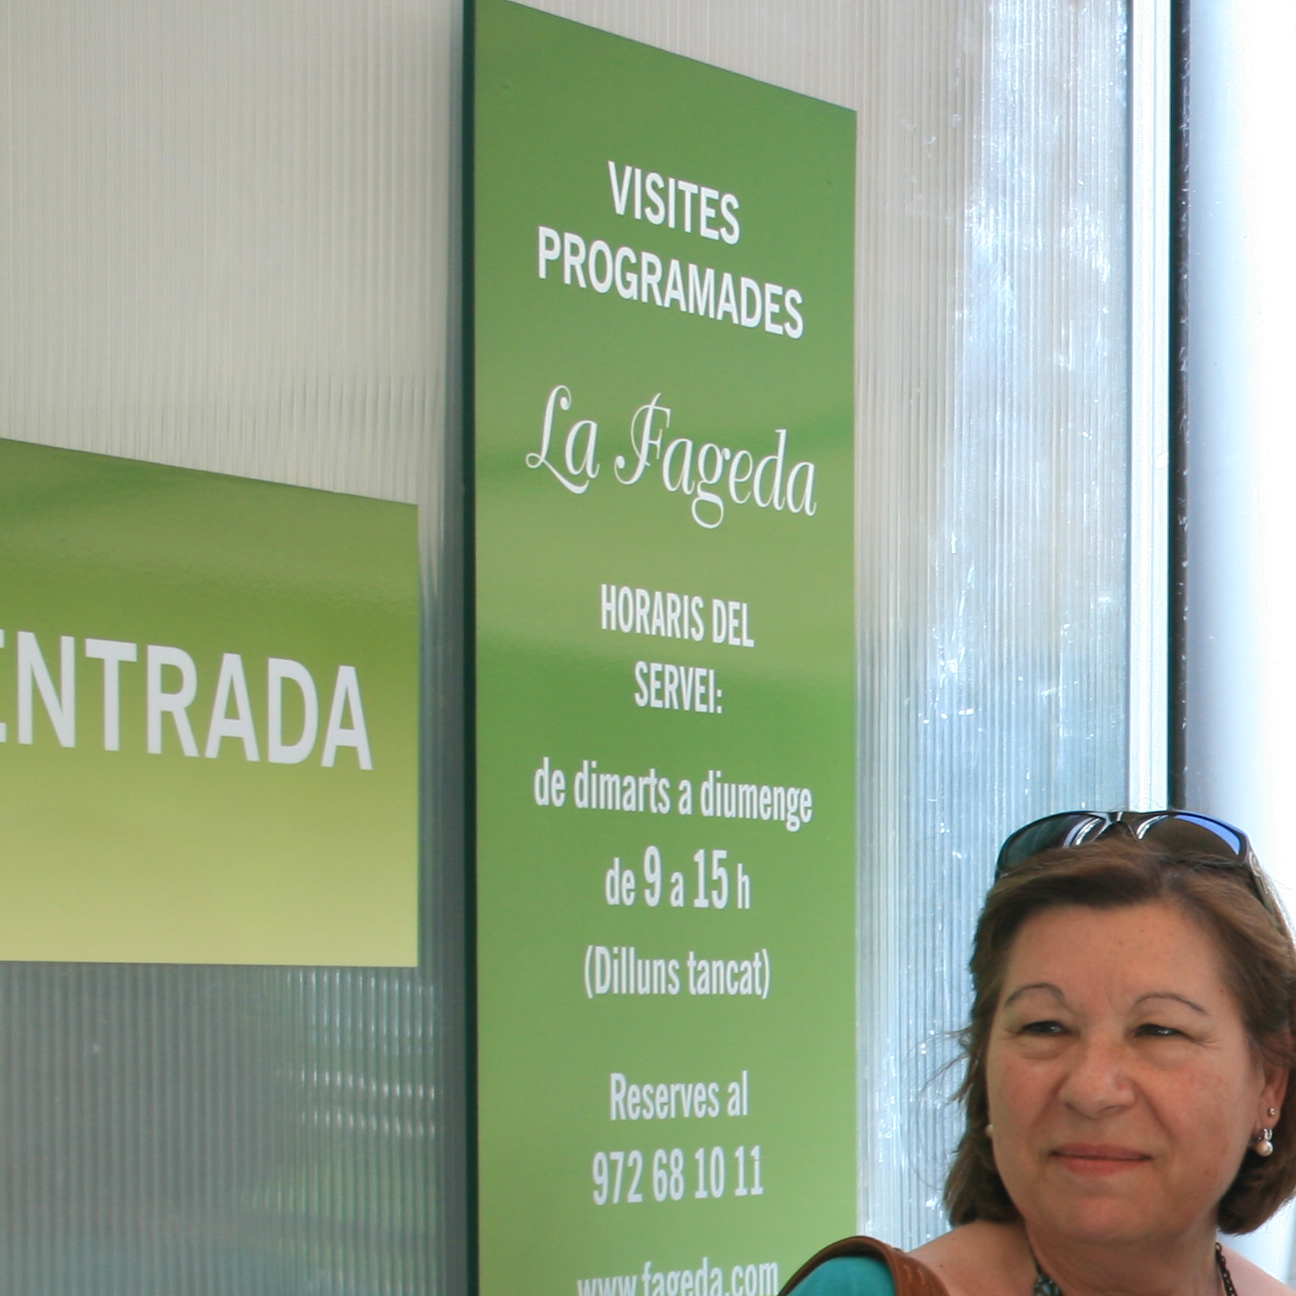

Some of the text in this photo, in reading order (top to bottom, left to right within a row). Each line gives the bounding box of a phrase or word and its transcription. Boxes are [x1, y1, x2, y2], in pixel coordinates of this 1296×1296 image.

[607, 160, 741, 246] VISITES
[538, 226, 804, 339] PROGRAMADES
[526, 384, 817, 529] La Fageda
[601, 583, 755, 648] HORARIS DEL
[0, 628, 373, 771] NTRADA
[634, 660, 723, 714] SERVEI:
[533, 756, 813, 833] de dimarts a diumenge
[605, 845, 751, 910] de 9 a 15 h
[584, 945, 771, 1000] (Dilluns tancat)
[610, 1070, 749, 1121] Reserves al
[592, 1145, 764, 1206] 972 68 10 11
